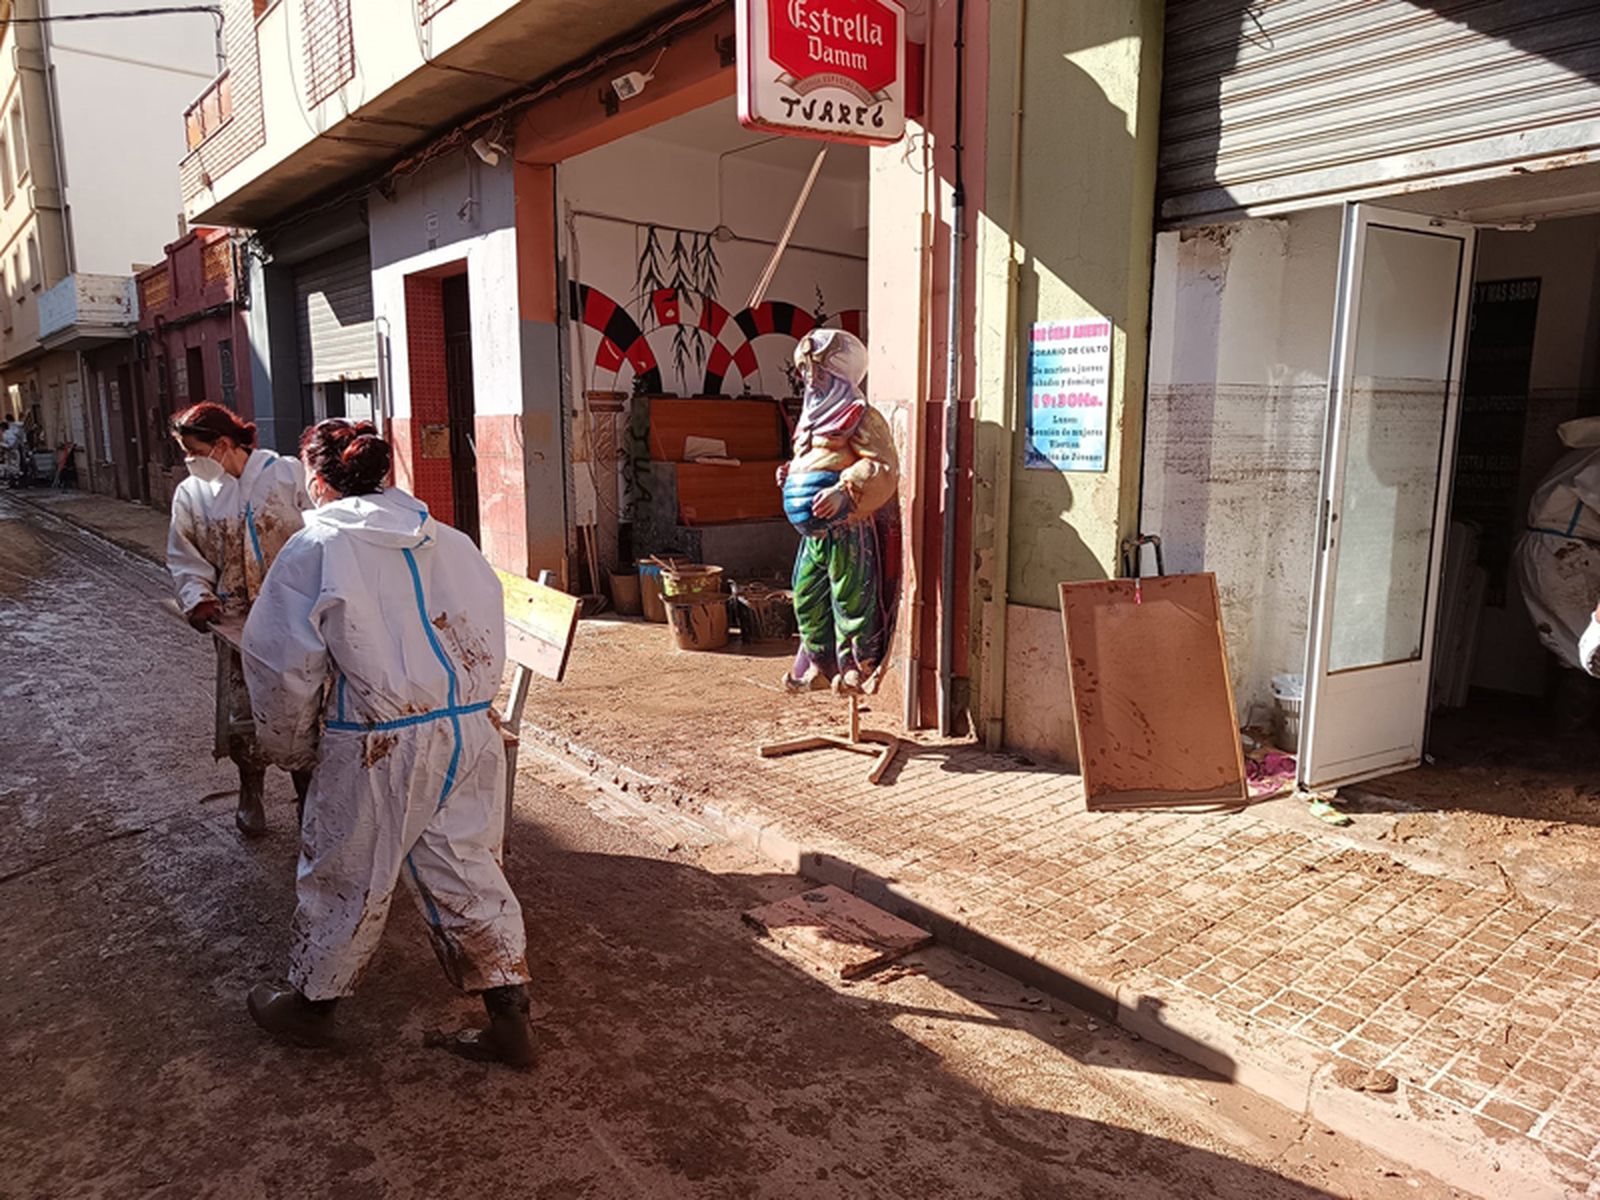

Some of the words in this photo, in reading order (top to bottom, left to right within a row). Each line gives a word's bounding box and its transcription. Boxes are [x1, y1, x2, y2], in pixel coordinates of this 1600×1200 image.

[788, 0, 883, 46] Estrella
[808, 35, 868, 70] Damm
[1067, 347, 1079, 355] DE
[1080, 345, 1109, 354] CULTO
[1077, 364, 1103, 374] jueves
[1072, 428, 1103, 438] mujeres
